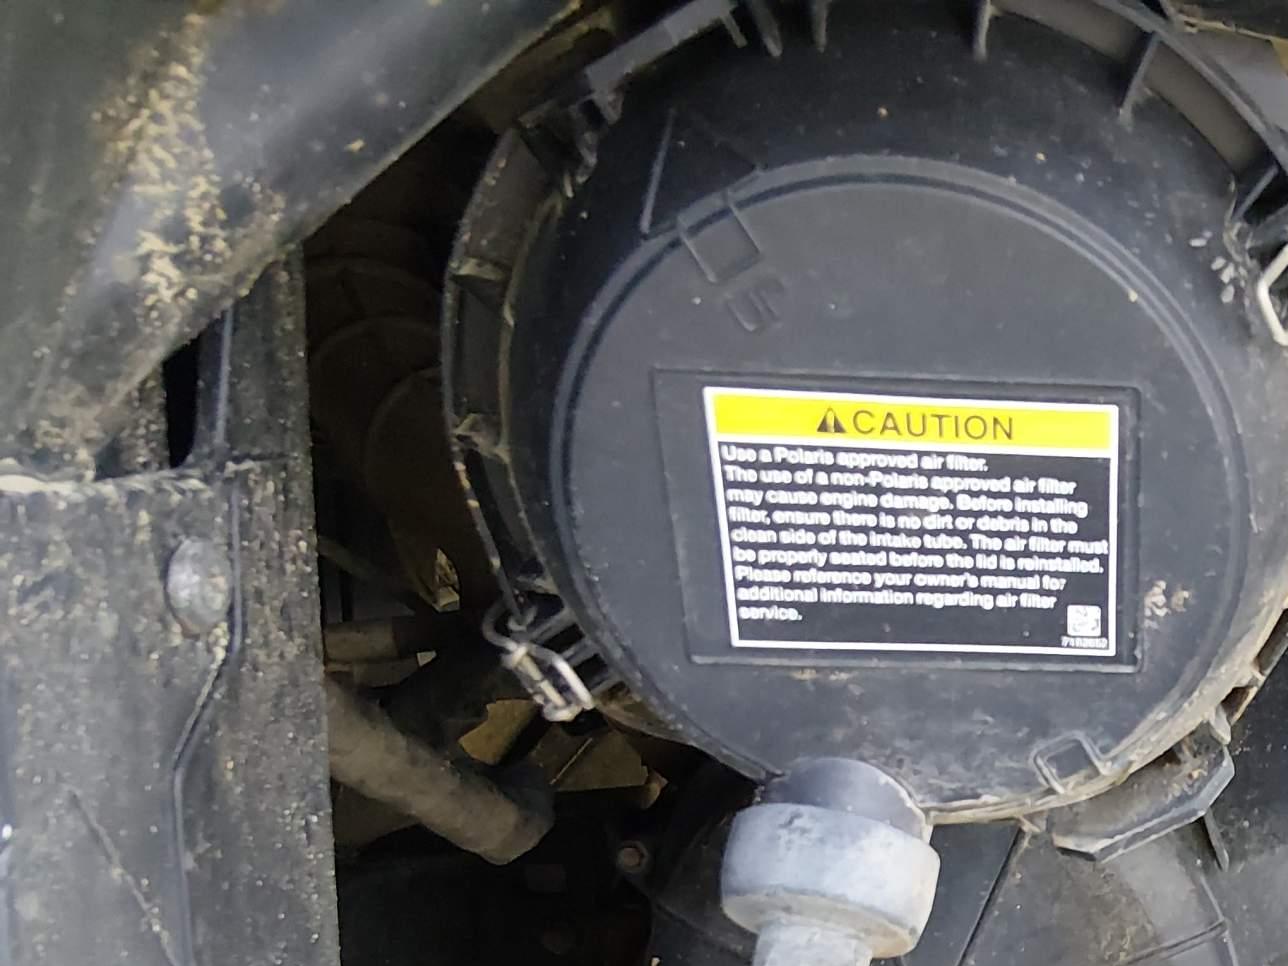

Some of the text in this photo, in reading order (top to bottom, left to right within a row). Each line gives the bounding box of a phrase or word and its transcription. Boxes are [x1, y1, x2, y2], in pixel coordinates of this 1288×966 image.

[853, 410, 1013, 440] CAUTION
[721, 445, 988, 471] Use a Polaris approved air filter.
[723, 465, 1077, 494] The use of a non-Polaris approved air filter
[726, 489, 1088, 518] may cause engine damage. Before installing
[728, 506, 1078, 534] filter, ensure there is no dirt or debris in the
[731, 527, 1108, 554] clean side of the intake tube. The air filter must
[733, 546, 1104, 573] be properly seated before the lid is reinstalled.
[734, 565, 1067, 590] Please reference your owner's manual for
[737, 586, 1057, 610] additional information regarding air filter
[738, 605, 803, 620] service.
